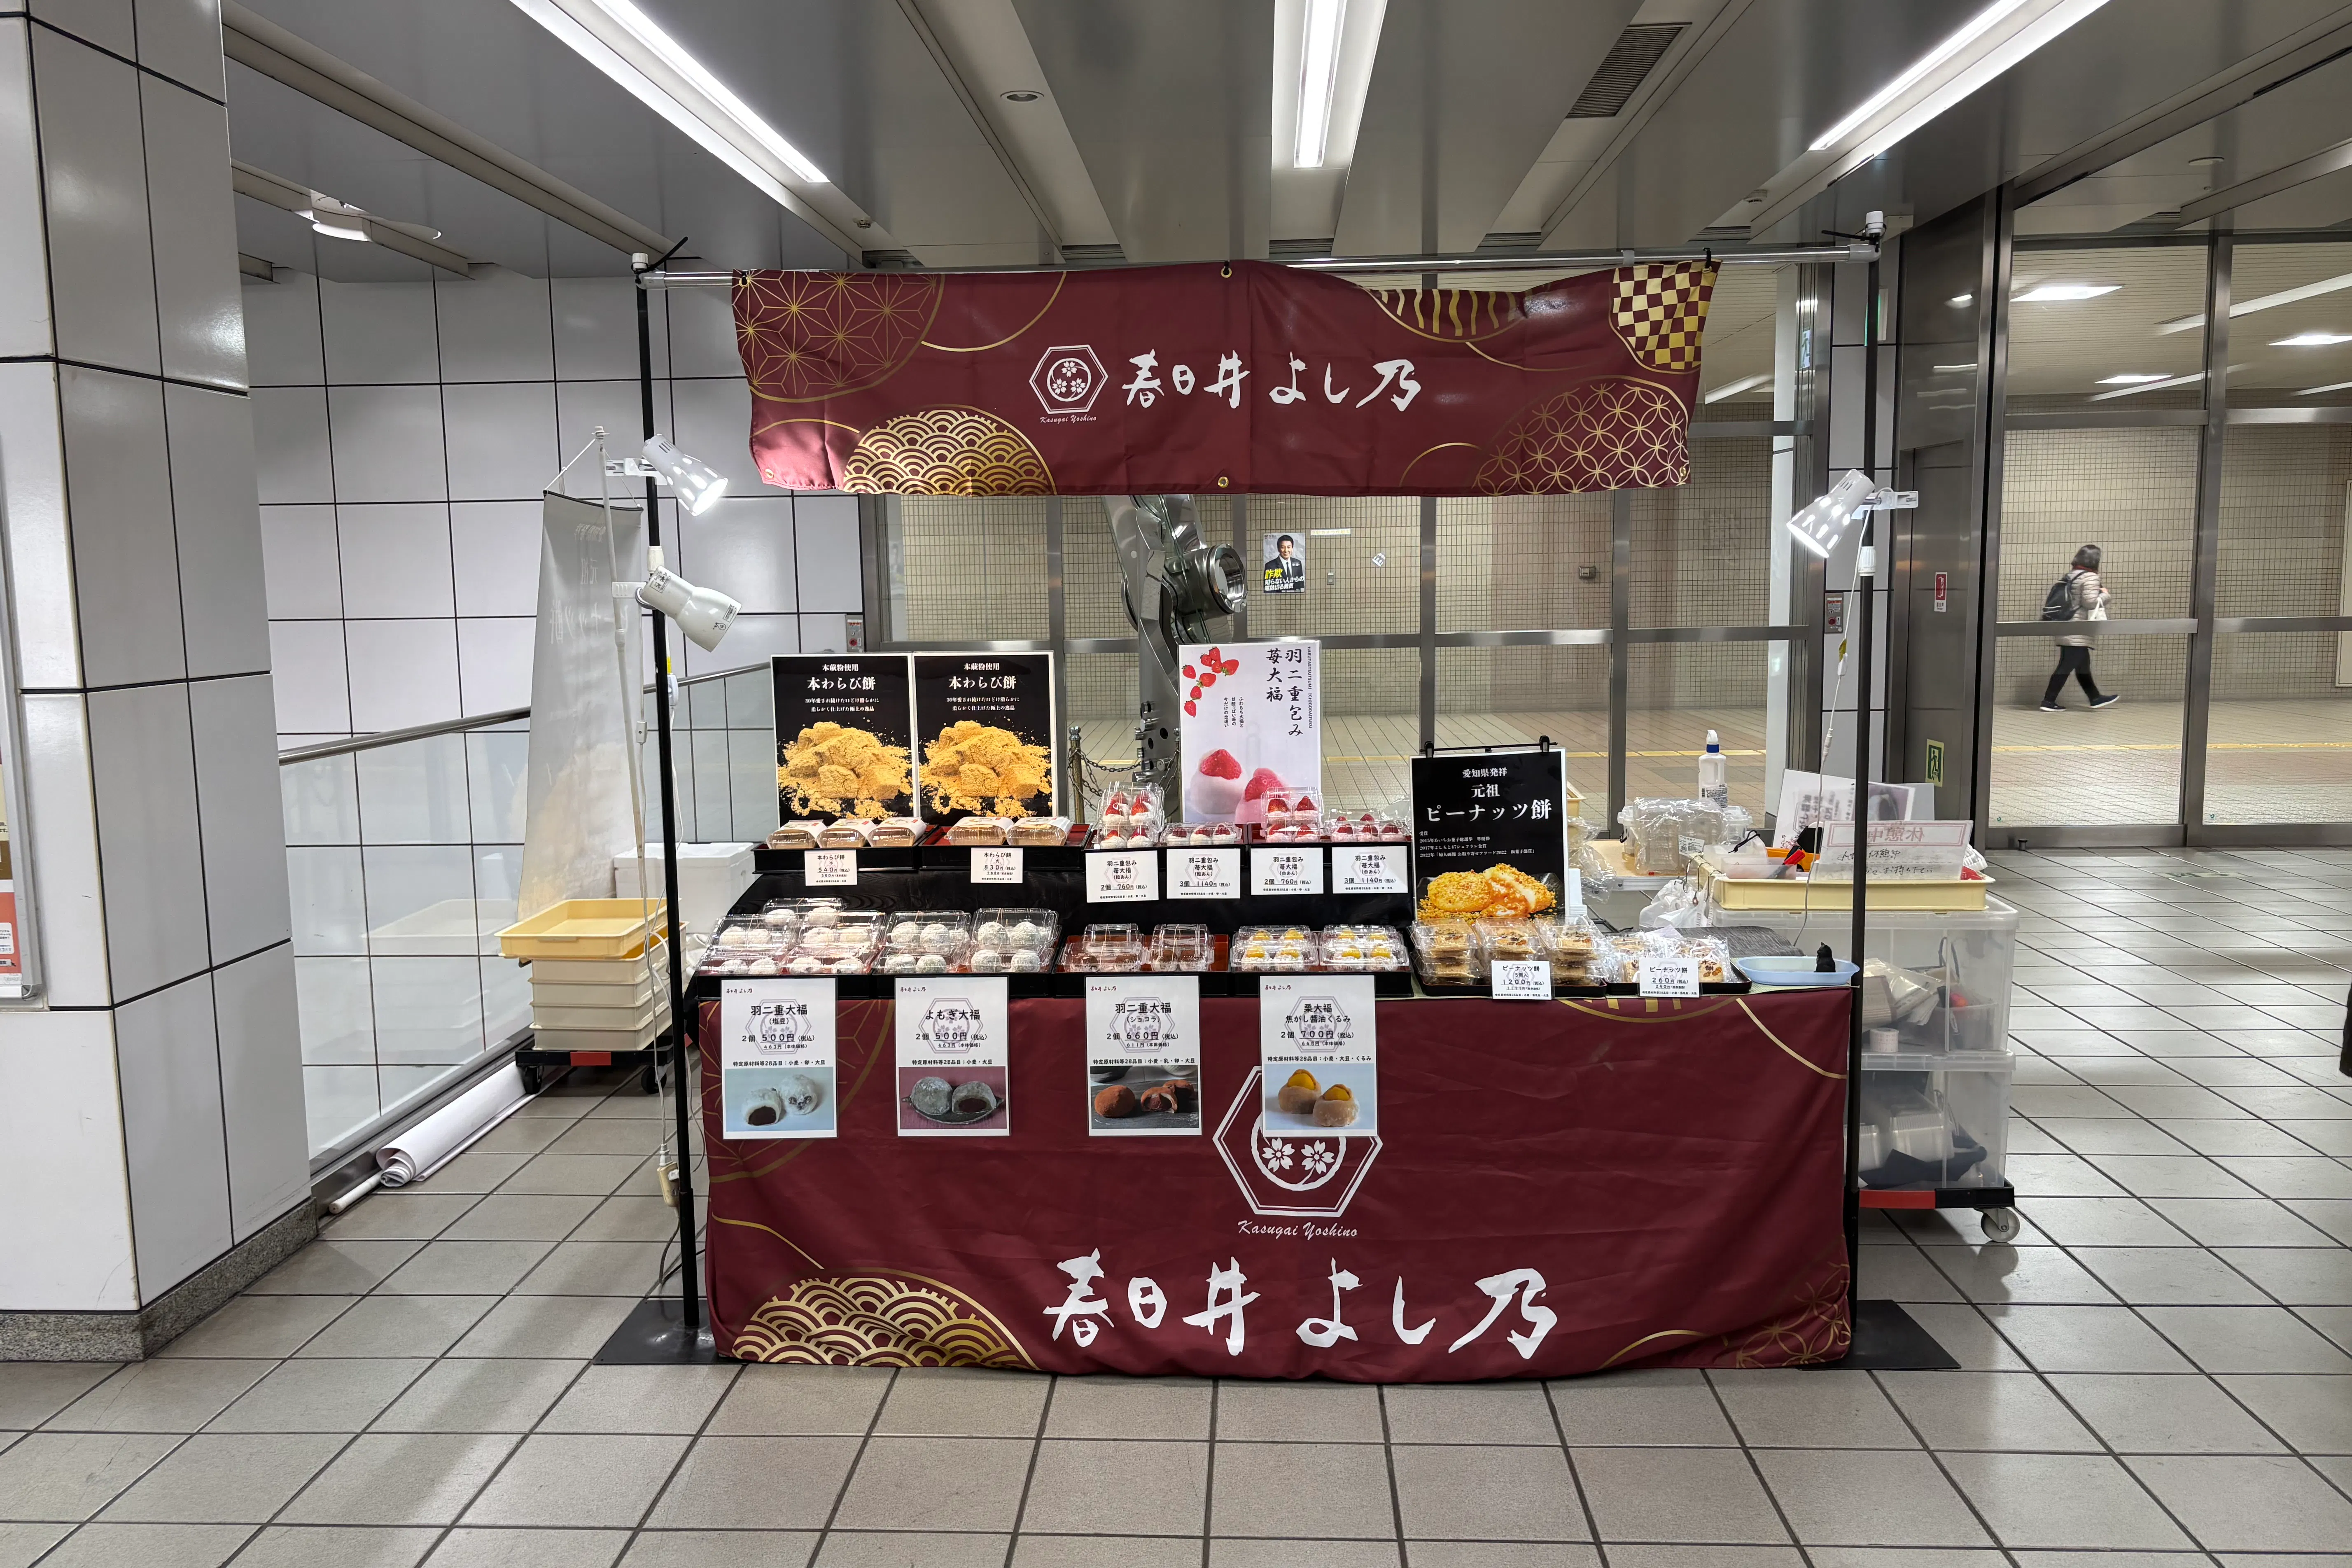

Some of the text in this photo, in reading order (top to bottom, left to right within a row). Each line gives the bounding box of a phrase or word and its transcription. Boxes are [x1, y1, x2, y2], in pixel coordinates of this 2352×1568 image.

[1040, 415, 1097, 424] Kasugai Yoshino
[1266, 648, 1283, 702] 苺大福
[807, 677, 876, 691] 本わらび餅
[949, 675, 1016, 690] 本わらび餅
[1285, 649, 1303, 736] 羽二重包み
[1462, 767, 1507, 778] 愛知県発祥
[1471, 784, 1500, 798] 元祖
[1427, 799, 1552, 822] ピーナッツ餅
[751, 1005, 807, 1015] 羽二重大福
[1115, 1002, 1171, 1013] 羽二重大福
[1304, 1004, 1332, 1013] 栗大福
[926, 1009, 980, 1020] よもぎ大福
[1127, 1031, 1158, 1040] 660円
[1238, 1220, 1358, 1239] Kasugai Yoshino
